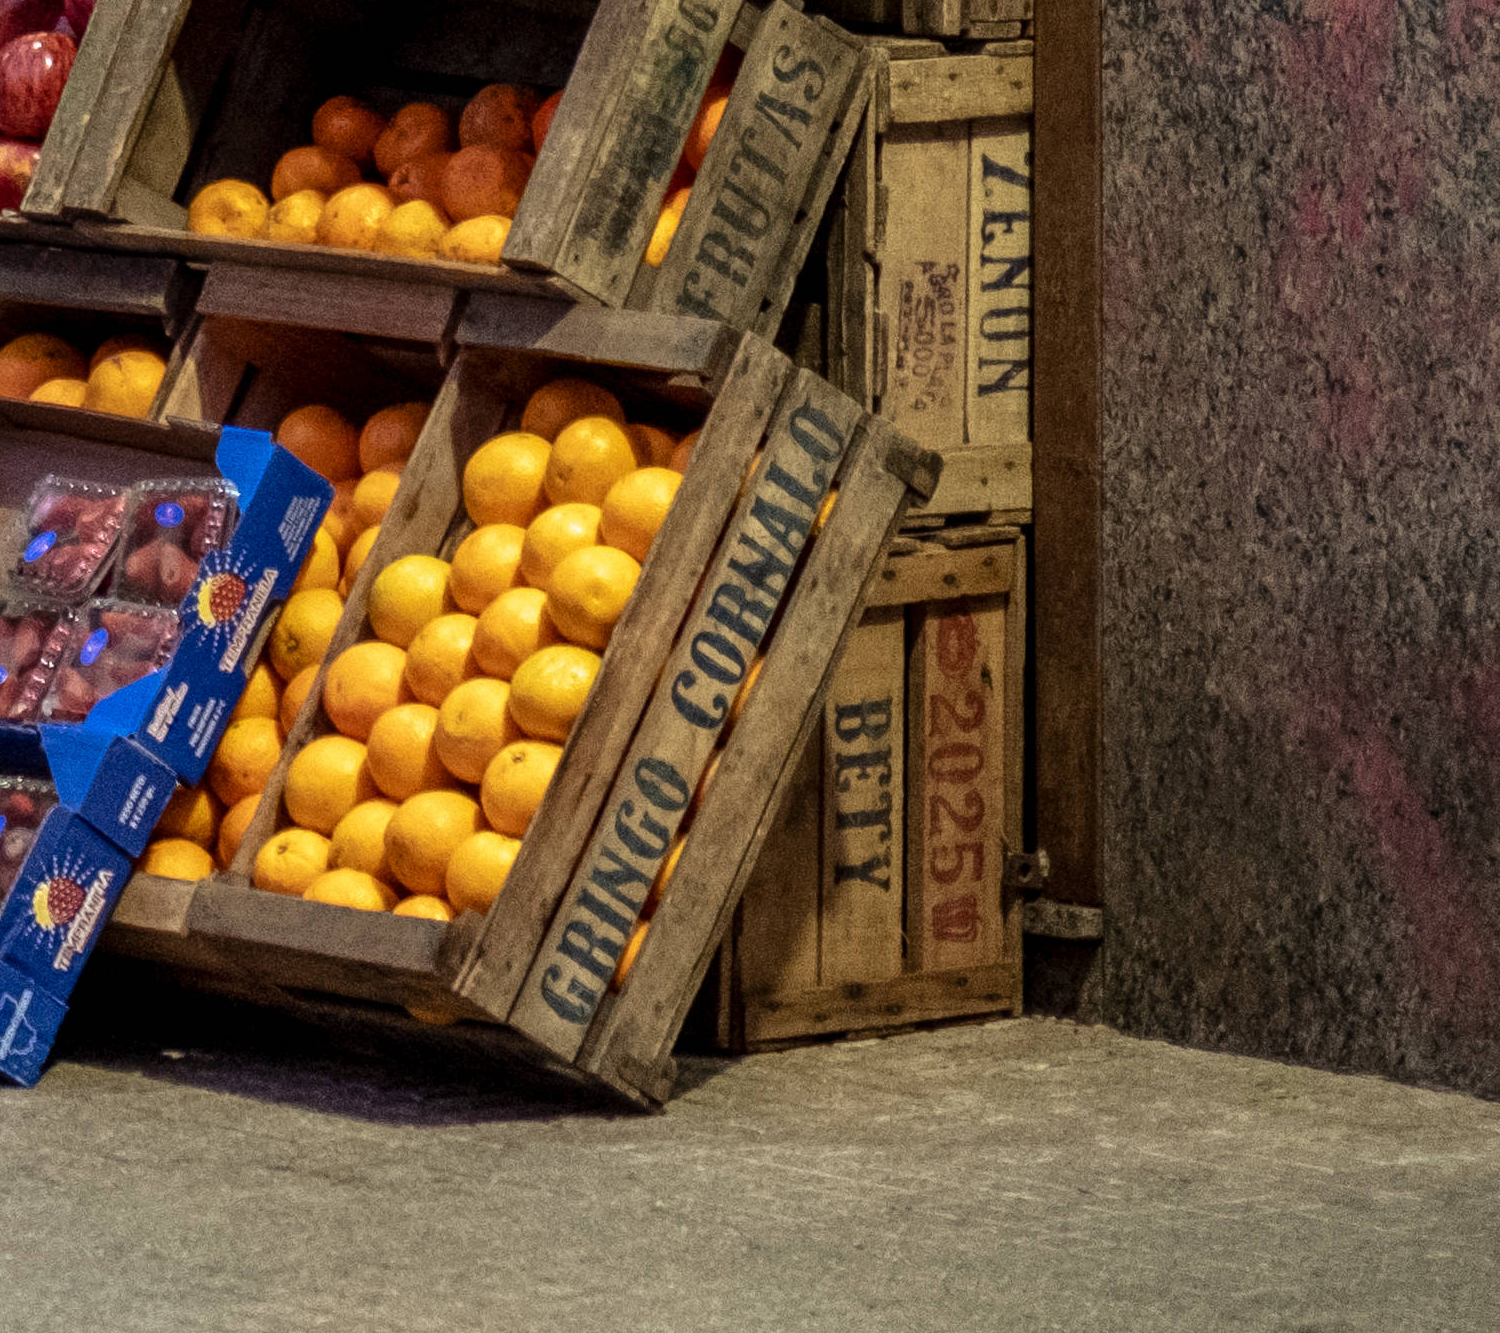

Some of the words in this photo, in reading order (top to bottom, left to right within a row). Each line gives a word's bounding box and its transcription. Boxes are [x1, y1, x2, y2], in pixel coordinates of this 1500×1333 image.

[674, 43, 826, 326] FRUTAS
[540, 755, 690, 1027] GRINGO
[670, 396, 848, 732] CORNALO
[834, 695, 894, 893] BETY
[927, 689, 987, 886] 2025
